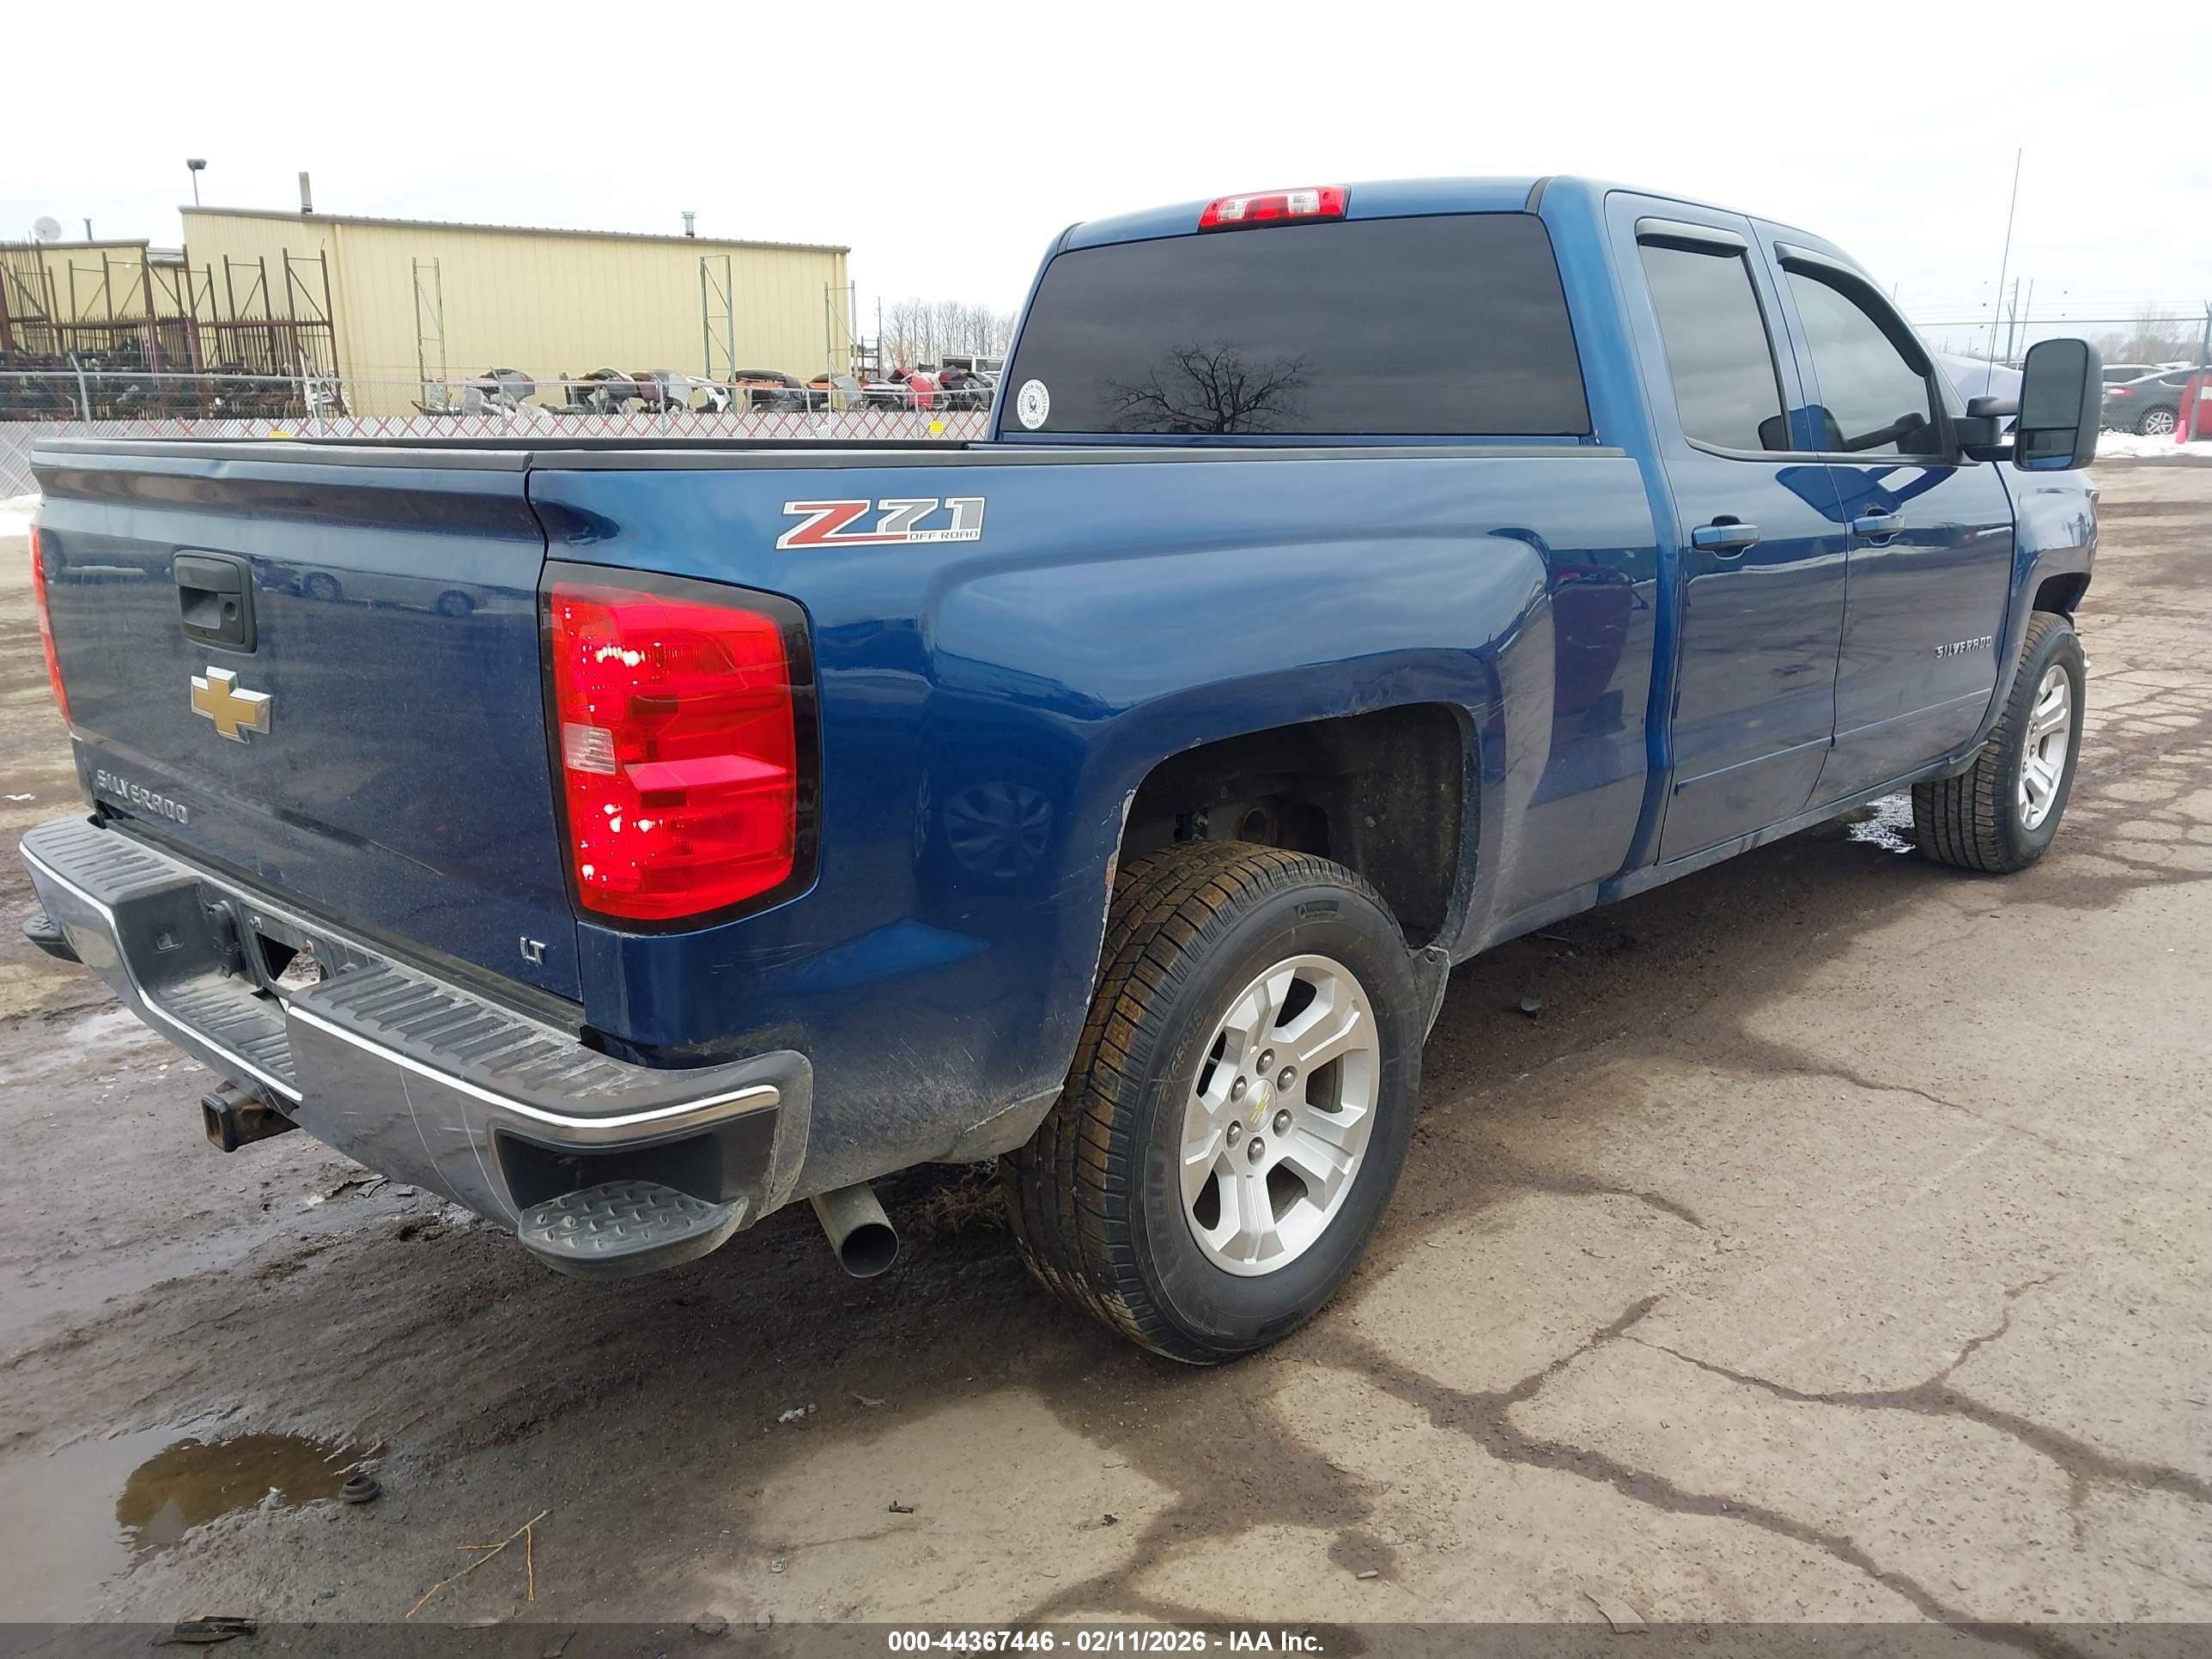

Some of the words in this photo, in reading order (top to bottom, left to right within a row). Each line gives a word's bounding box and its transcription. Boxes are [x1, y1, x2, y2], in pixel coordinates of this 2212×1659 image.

[775, 496, 986, 550] Z71
[909, 532, 937, 541] OFF
[940, 529, 979, 540] ROAD
[1936, 635, 1992, 659] SILVERADO
[96, 769, 188, 825] SILVERADO
[520, 936, 546, 966] LT
